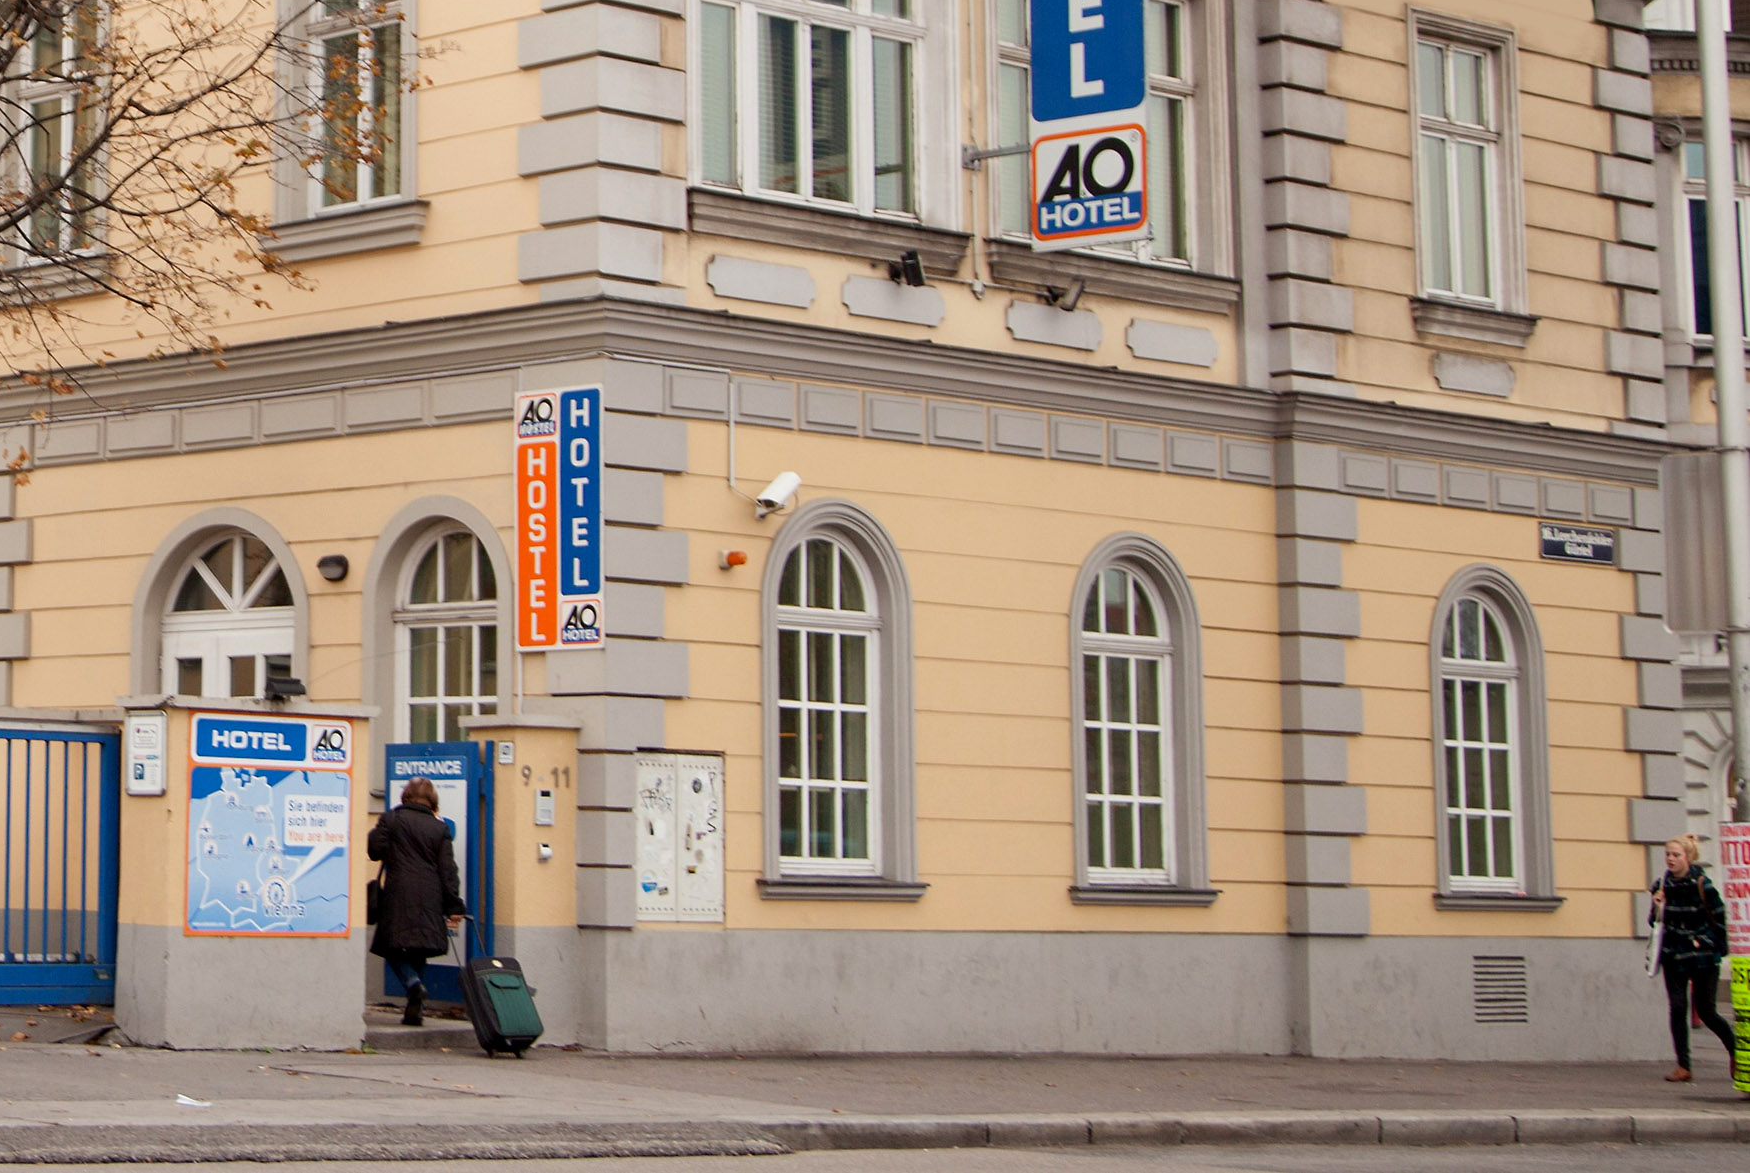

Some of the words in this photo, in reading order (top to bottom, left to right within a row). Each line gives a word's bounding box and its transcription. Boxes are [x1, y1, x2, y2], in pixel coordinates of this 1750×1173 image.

[1040, 196, 1141, 230] HOTEL
[519, 420, 556, 437] HOSTEL
[570, 397, 590, 588] HOTEL
[527, 447, 547, 642] HOSTEL
[562, 628, 599, 643] HOTEL
[211, 729, 292, 751] HOTEL
[314, 749, 346, 762] HOTEL
[395, 760, 463, 776] ENTRANCE
[521, 765, 532, 787] 9
[550, 766, 571, 789] 11
[288, 799, 303, 812] Sie
[288, 816, 307, 827] sich
